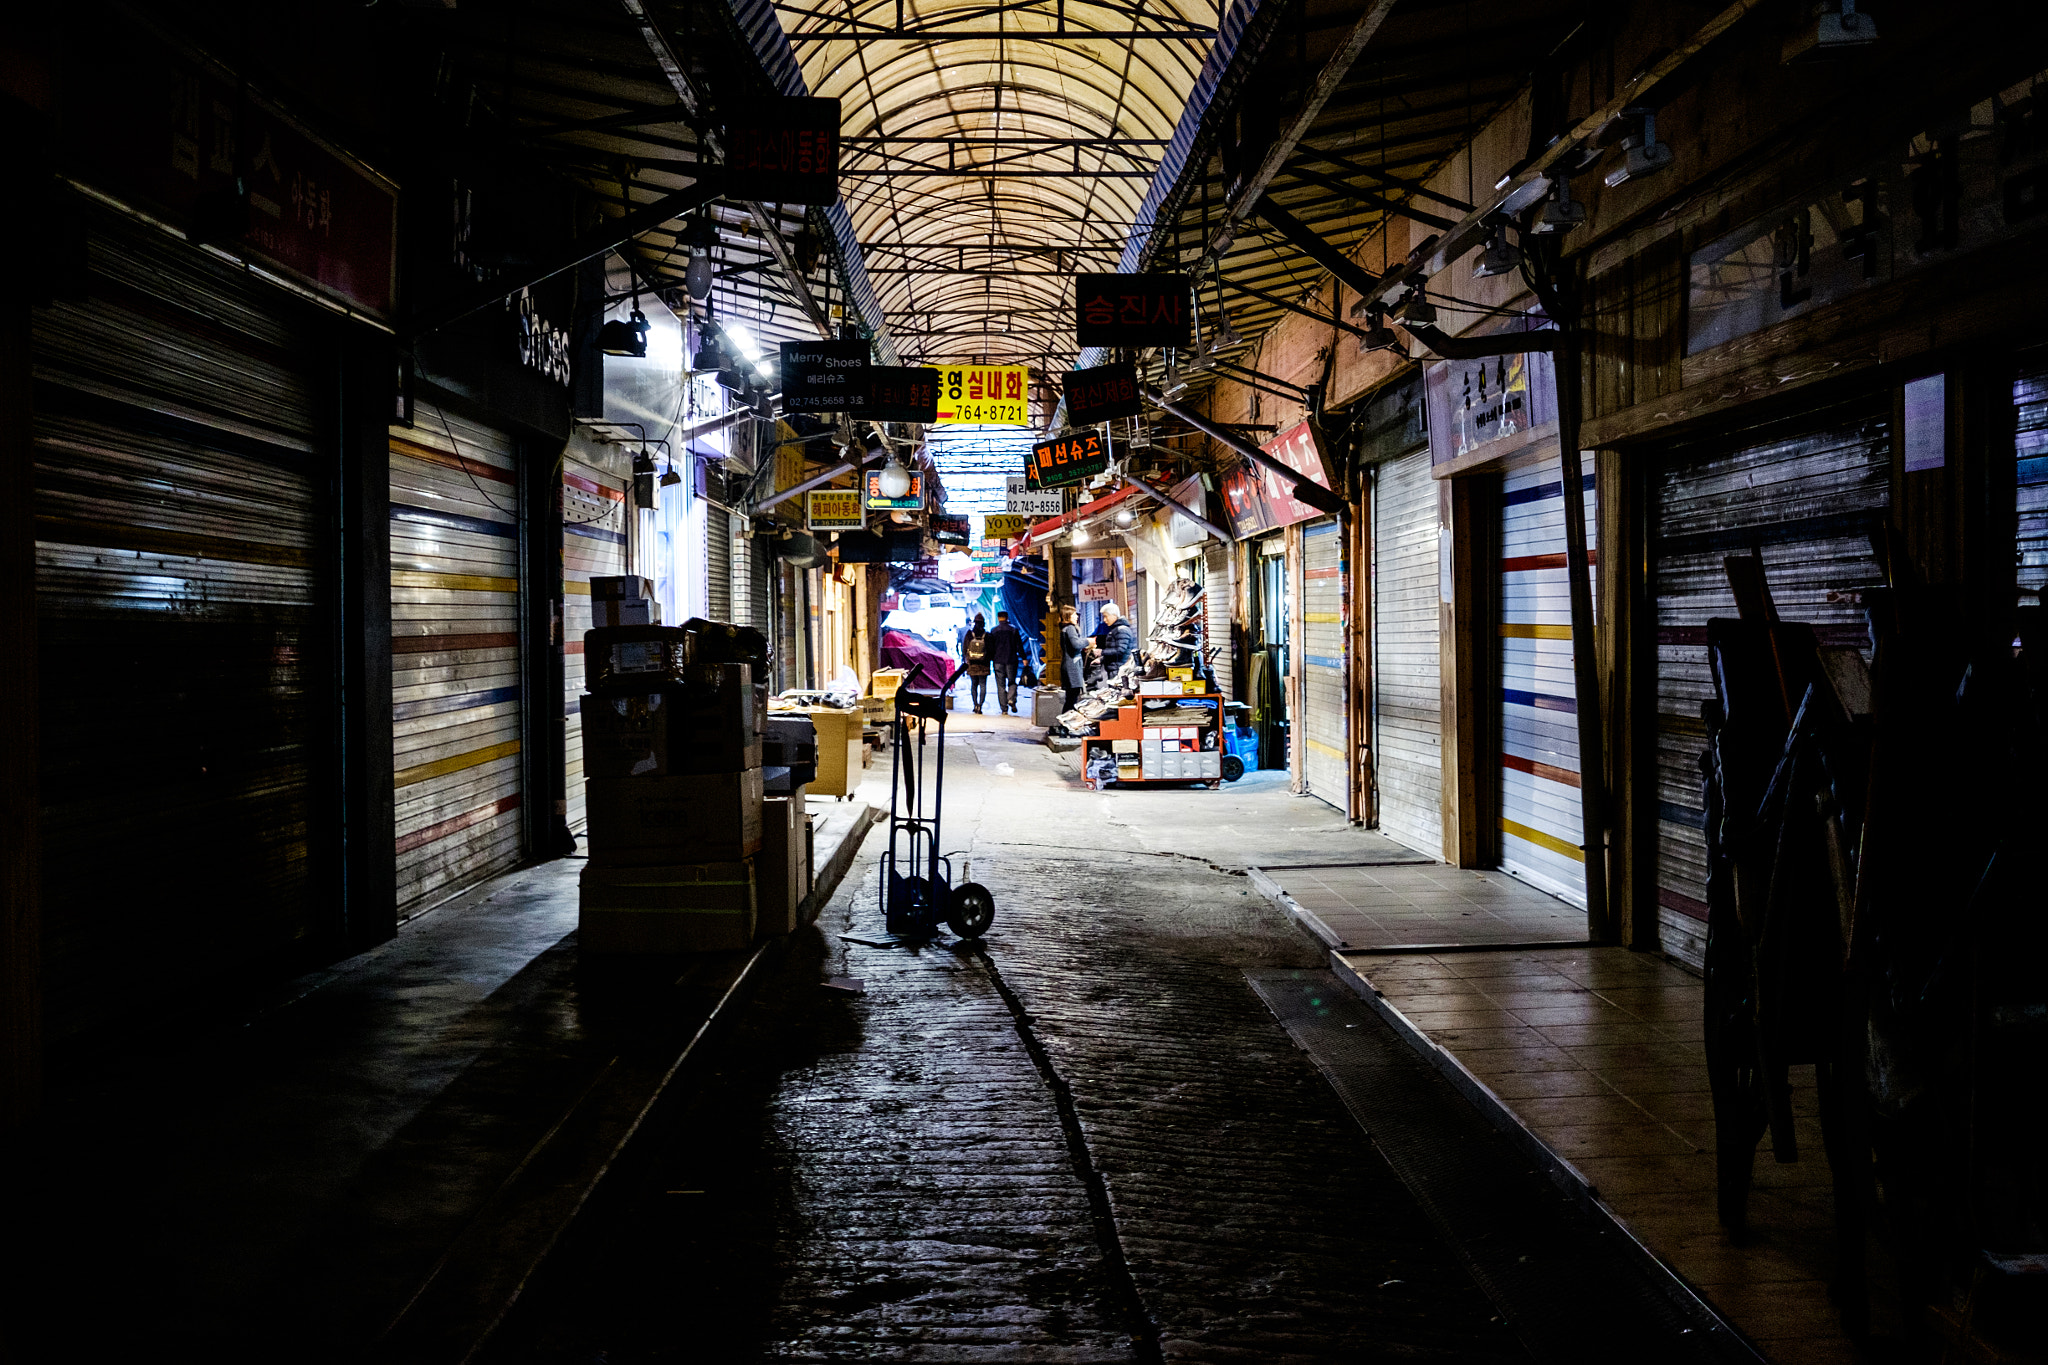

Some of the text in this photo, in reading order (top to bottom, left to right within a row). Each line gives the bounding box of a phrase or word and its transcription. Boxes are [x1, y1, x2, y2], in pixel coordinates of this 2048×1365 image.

[1084, 294, 1183, 326] 승진사
[518, 285, 571, 388] Shoes
[789, 352, 862, 368] Merry Shoes
[956, 405, 1022, 420] 764-8721
[1007, 500, 1060, 513] 02.743-8556
[987, 516, 1021, 529] YO YO
[1083, 586, 1109, 597] 바다
